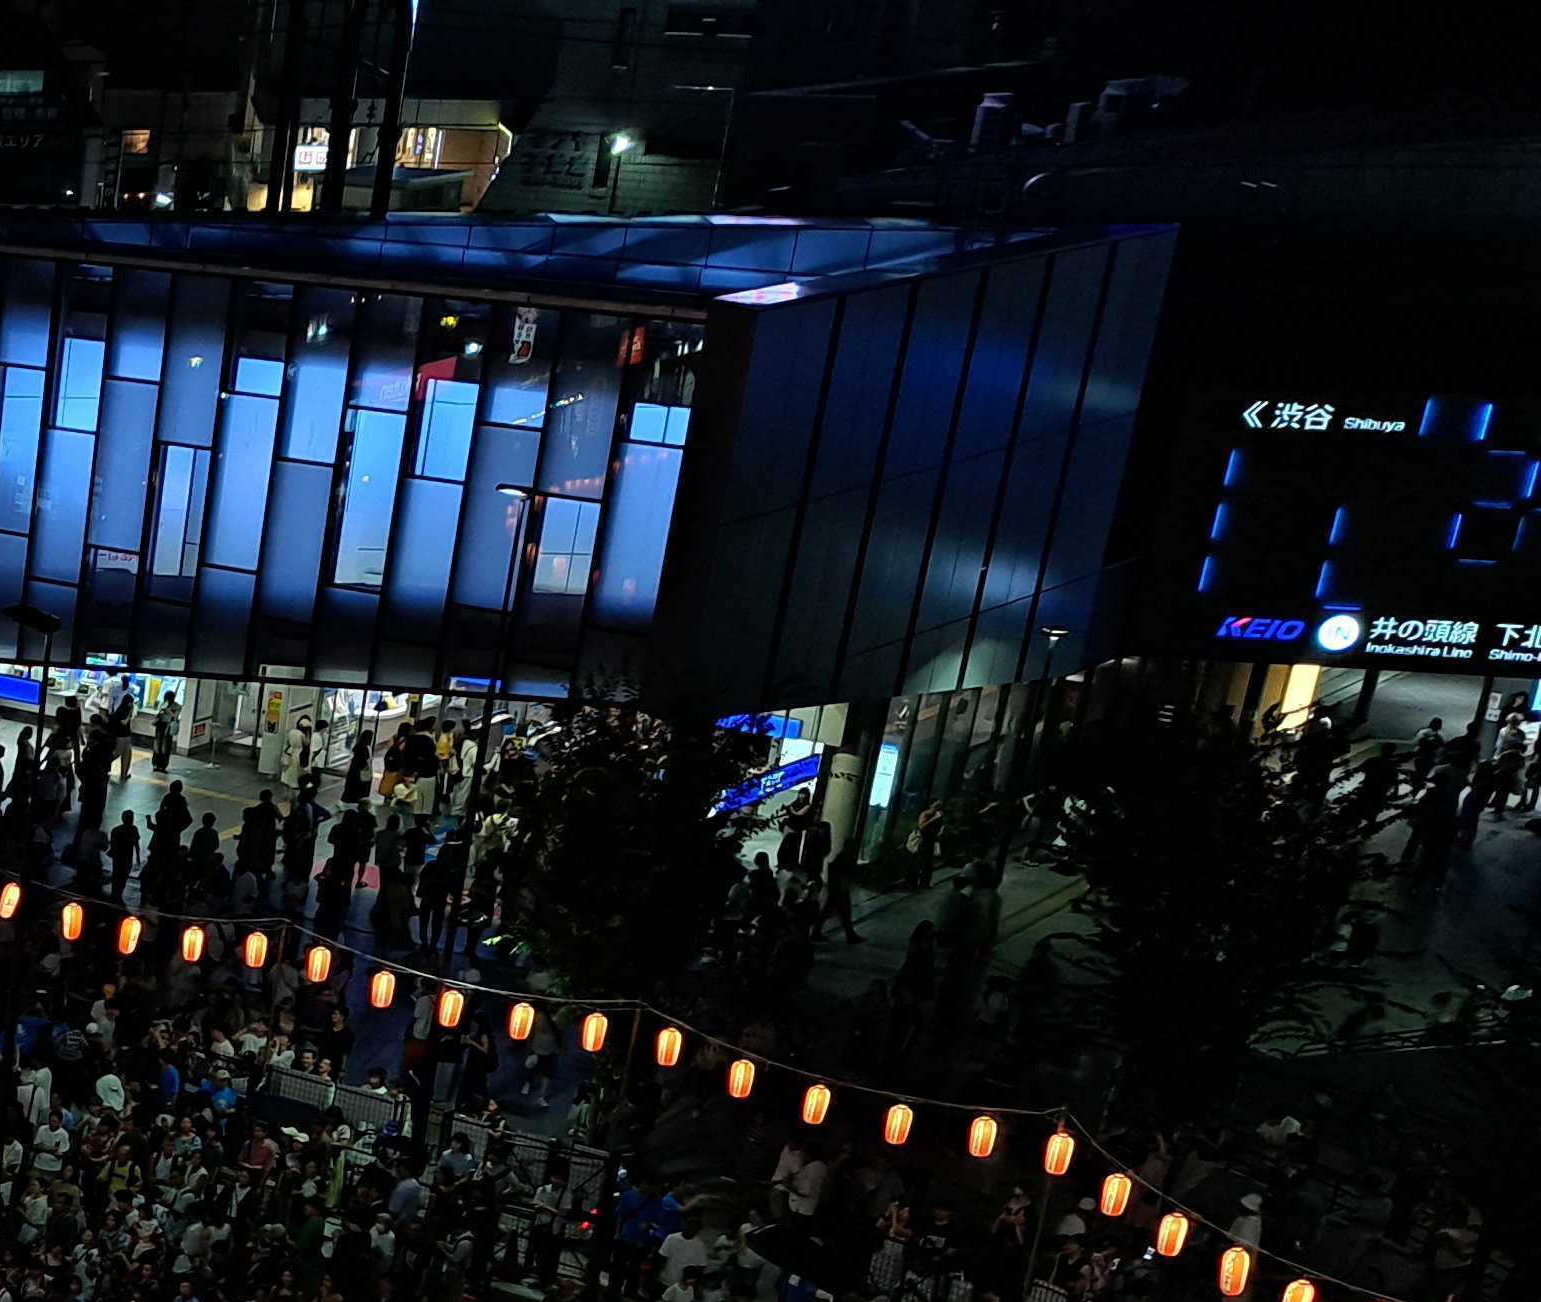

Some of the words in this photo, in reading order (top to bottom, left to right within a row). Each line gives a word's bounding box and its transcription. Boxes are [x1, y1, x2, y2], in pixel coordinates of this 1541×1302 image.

[1269, 401, 1336, 431] 渋谷
[1342, 416, 1407, 433] Shibuya
[1215, 615, 1307, 642] KEIO
[1369, 615, 1480, 645] 井の頭線
[1365, 641, 1441, 657] Inokashira
[1442, 646, 1473, 659] Line
